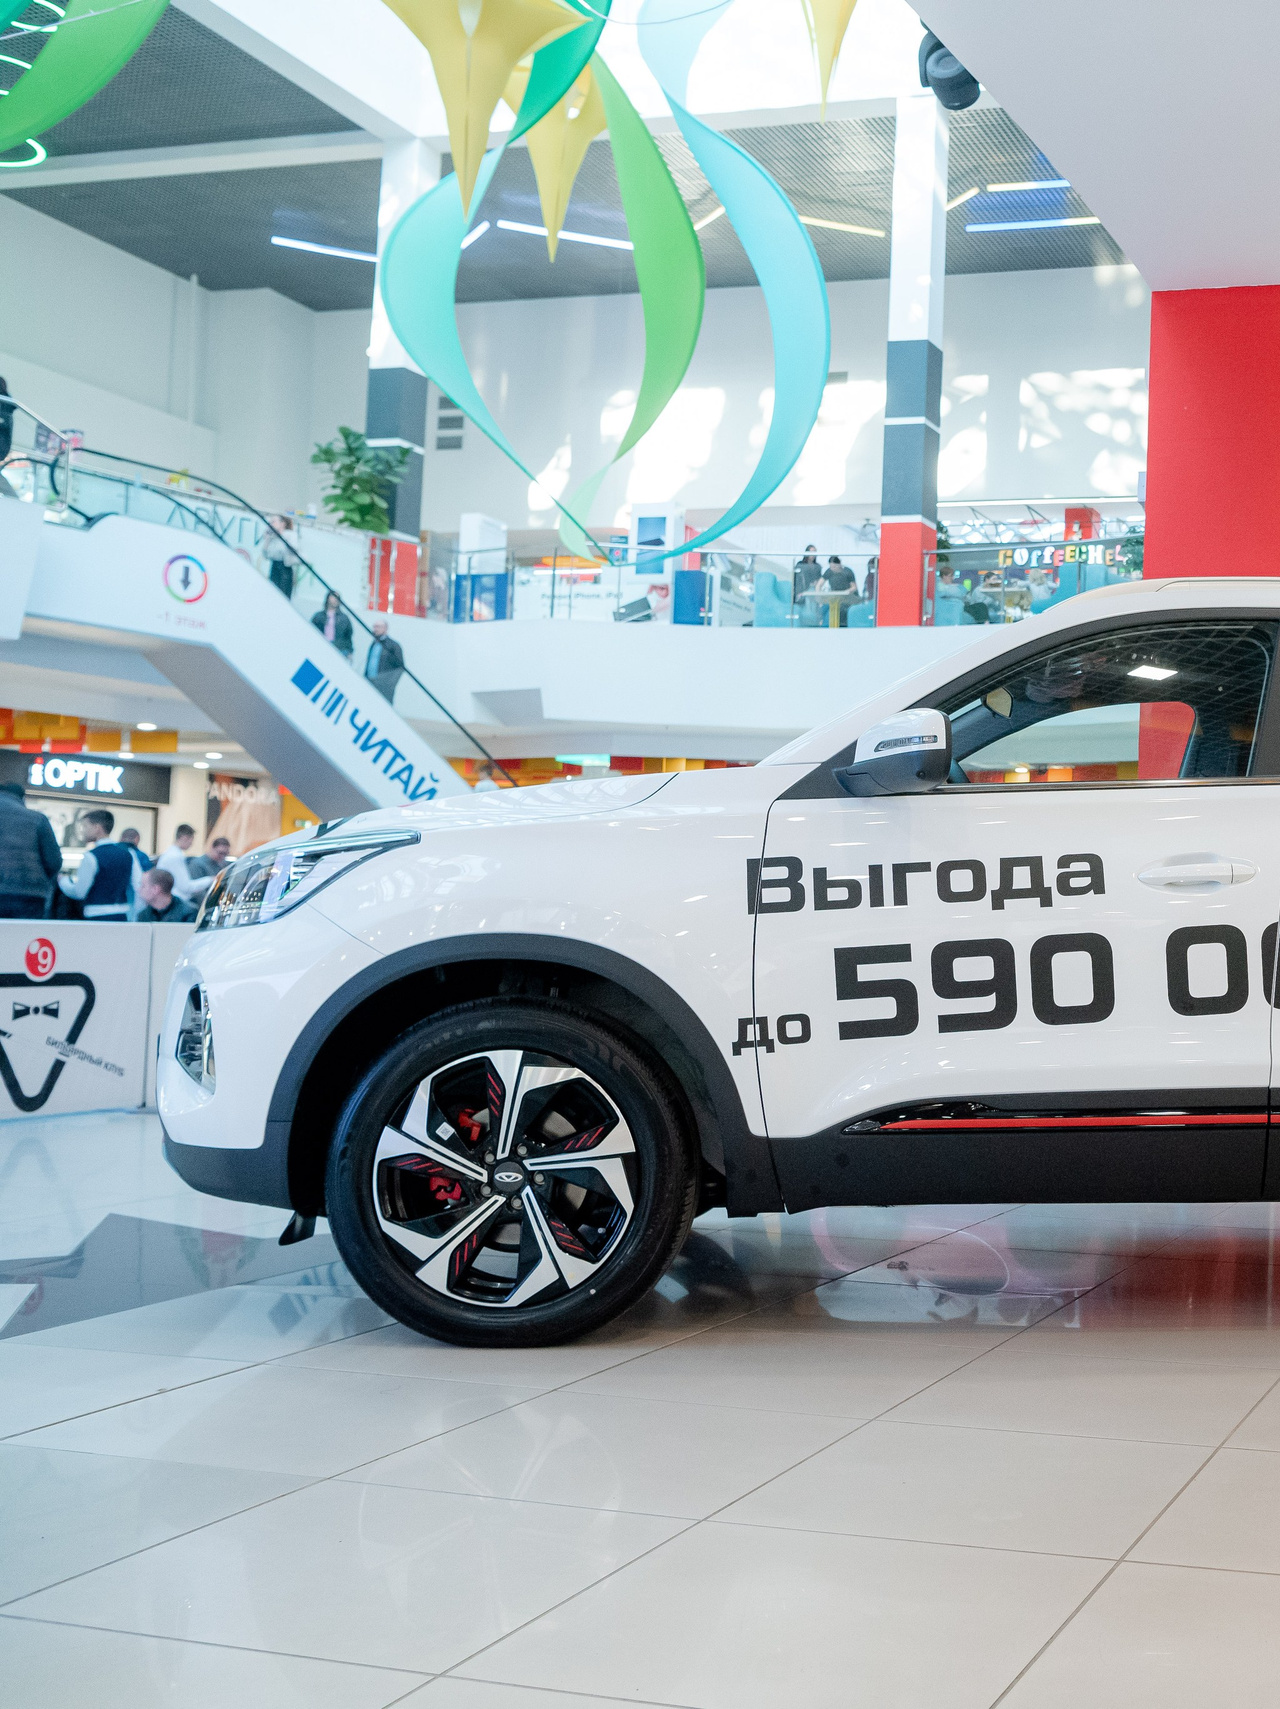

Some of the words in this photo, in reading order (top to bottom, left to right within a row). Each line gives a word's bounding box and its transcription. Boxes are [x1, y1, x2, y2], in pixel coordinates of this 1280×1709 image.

[746, 852, 1106, 915] Выгода
[37, 946, 53, 974] 9
[732, 1012, 811, 1056] до
[833, 932, 1116, 1041] 590
